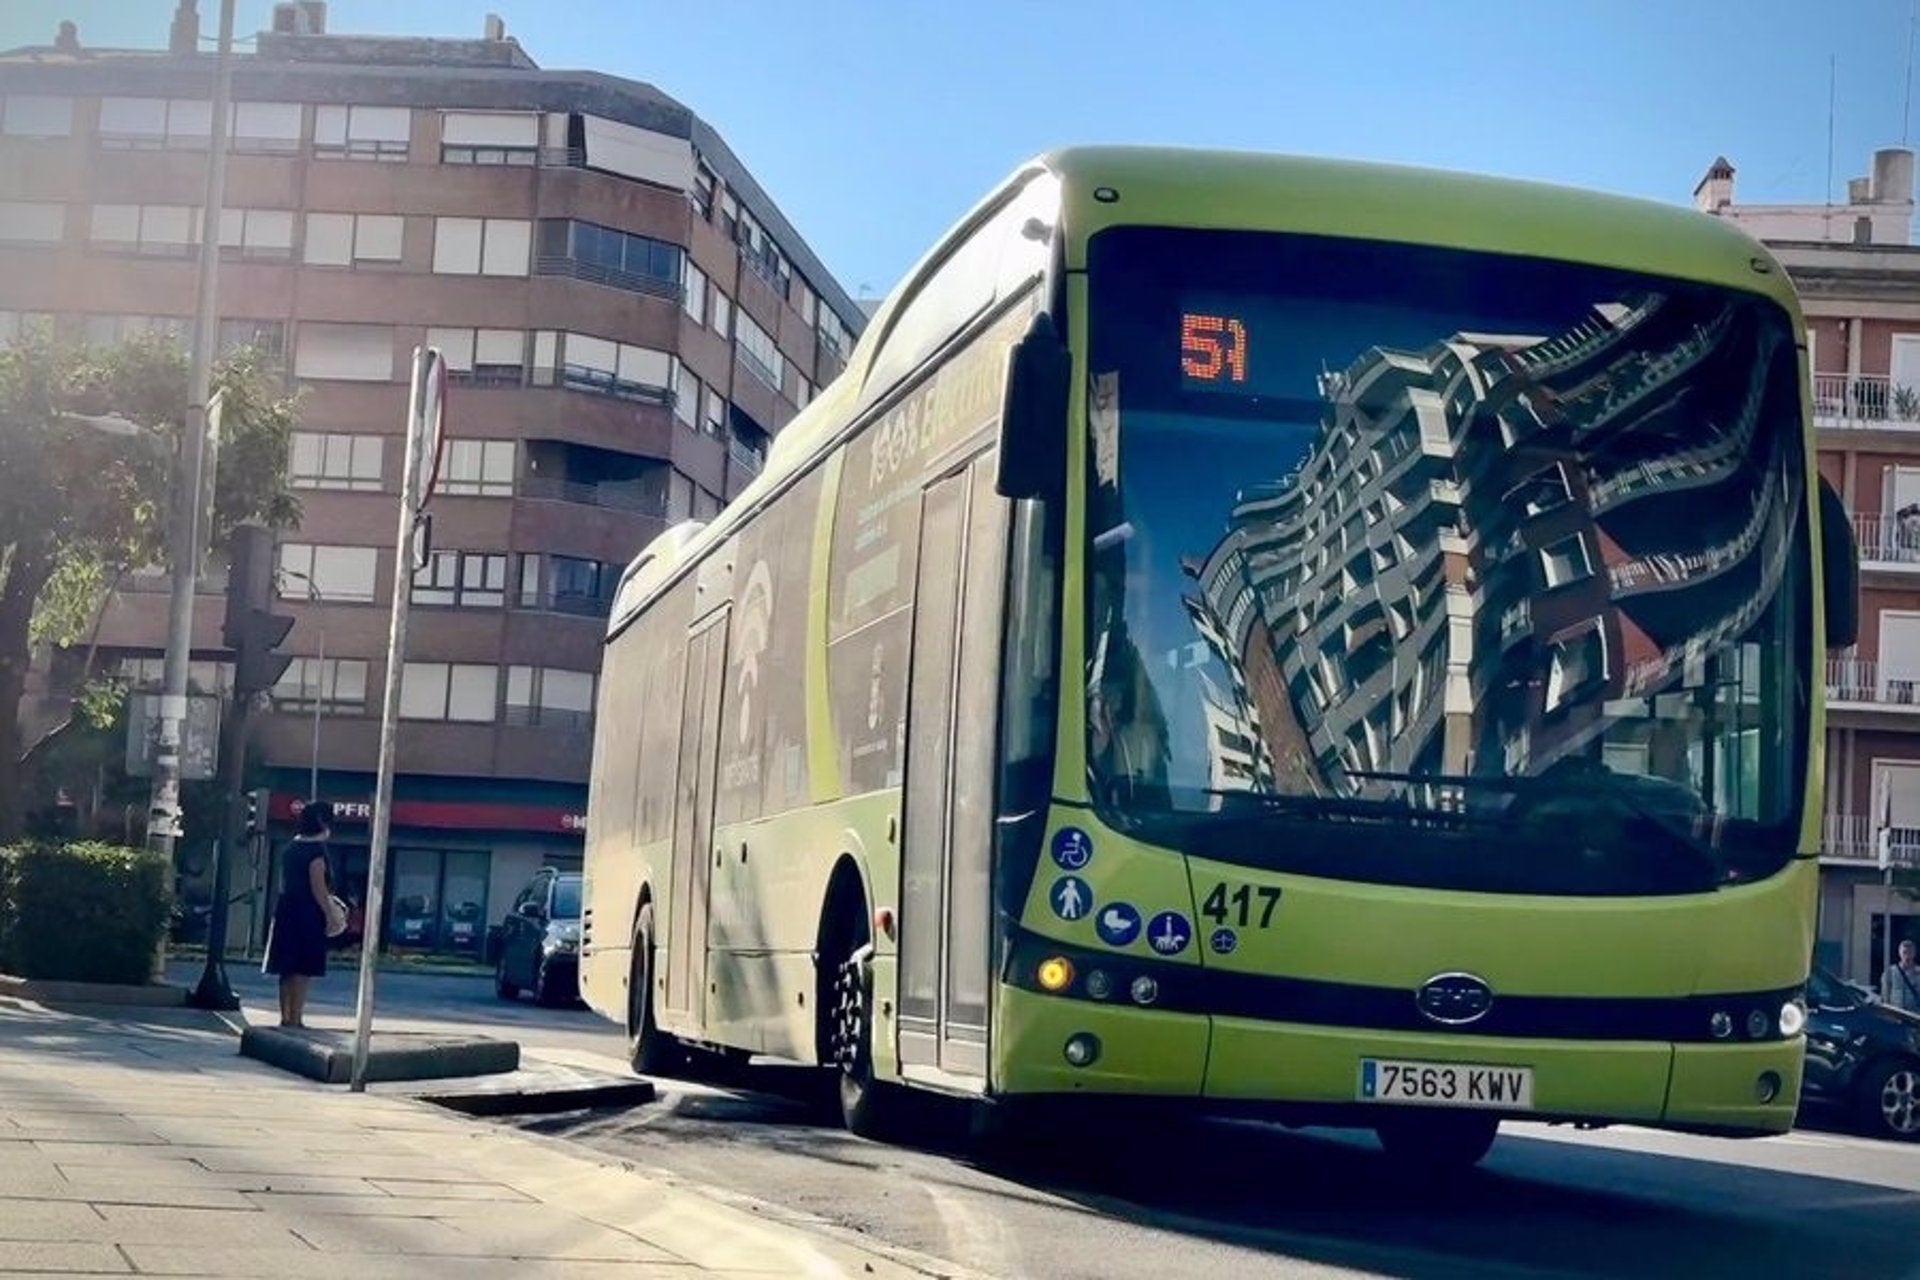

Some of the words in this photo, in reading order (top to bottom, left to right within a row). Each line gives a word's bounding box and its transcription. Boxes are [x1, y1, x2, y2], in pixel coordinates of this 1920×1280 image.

[1181, 314, 1246, 381] 51
[1202, 882, 1282, 929] 417
[1383, 1066, 1457, 1099] 7563
[1468, 1070, 1523, 1102] KWV
